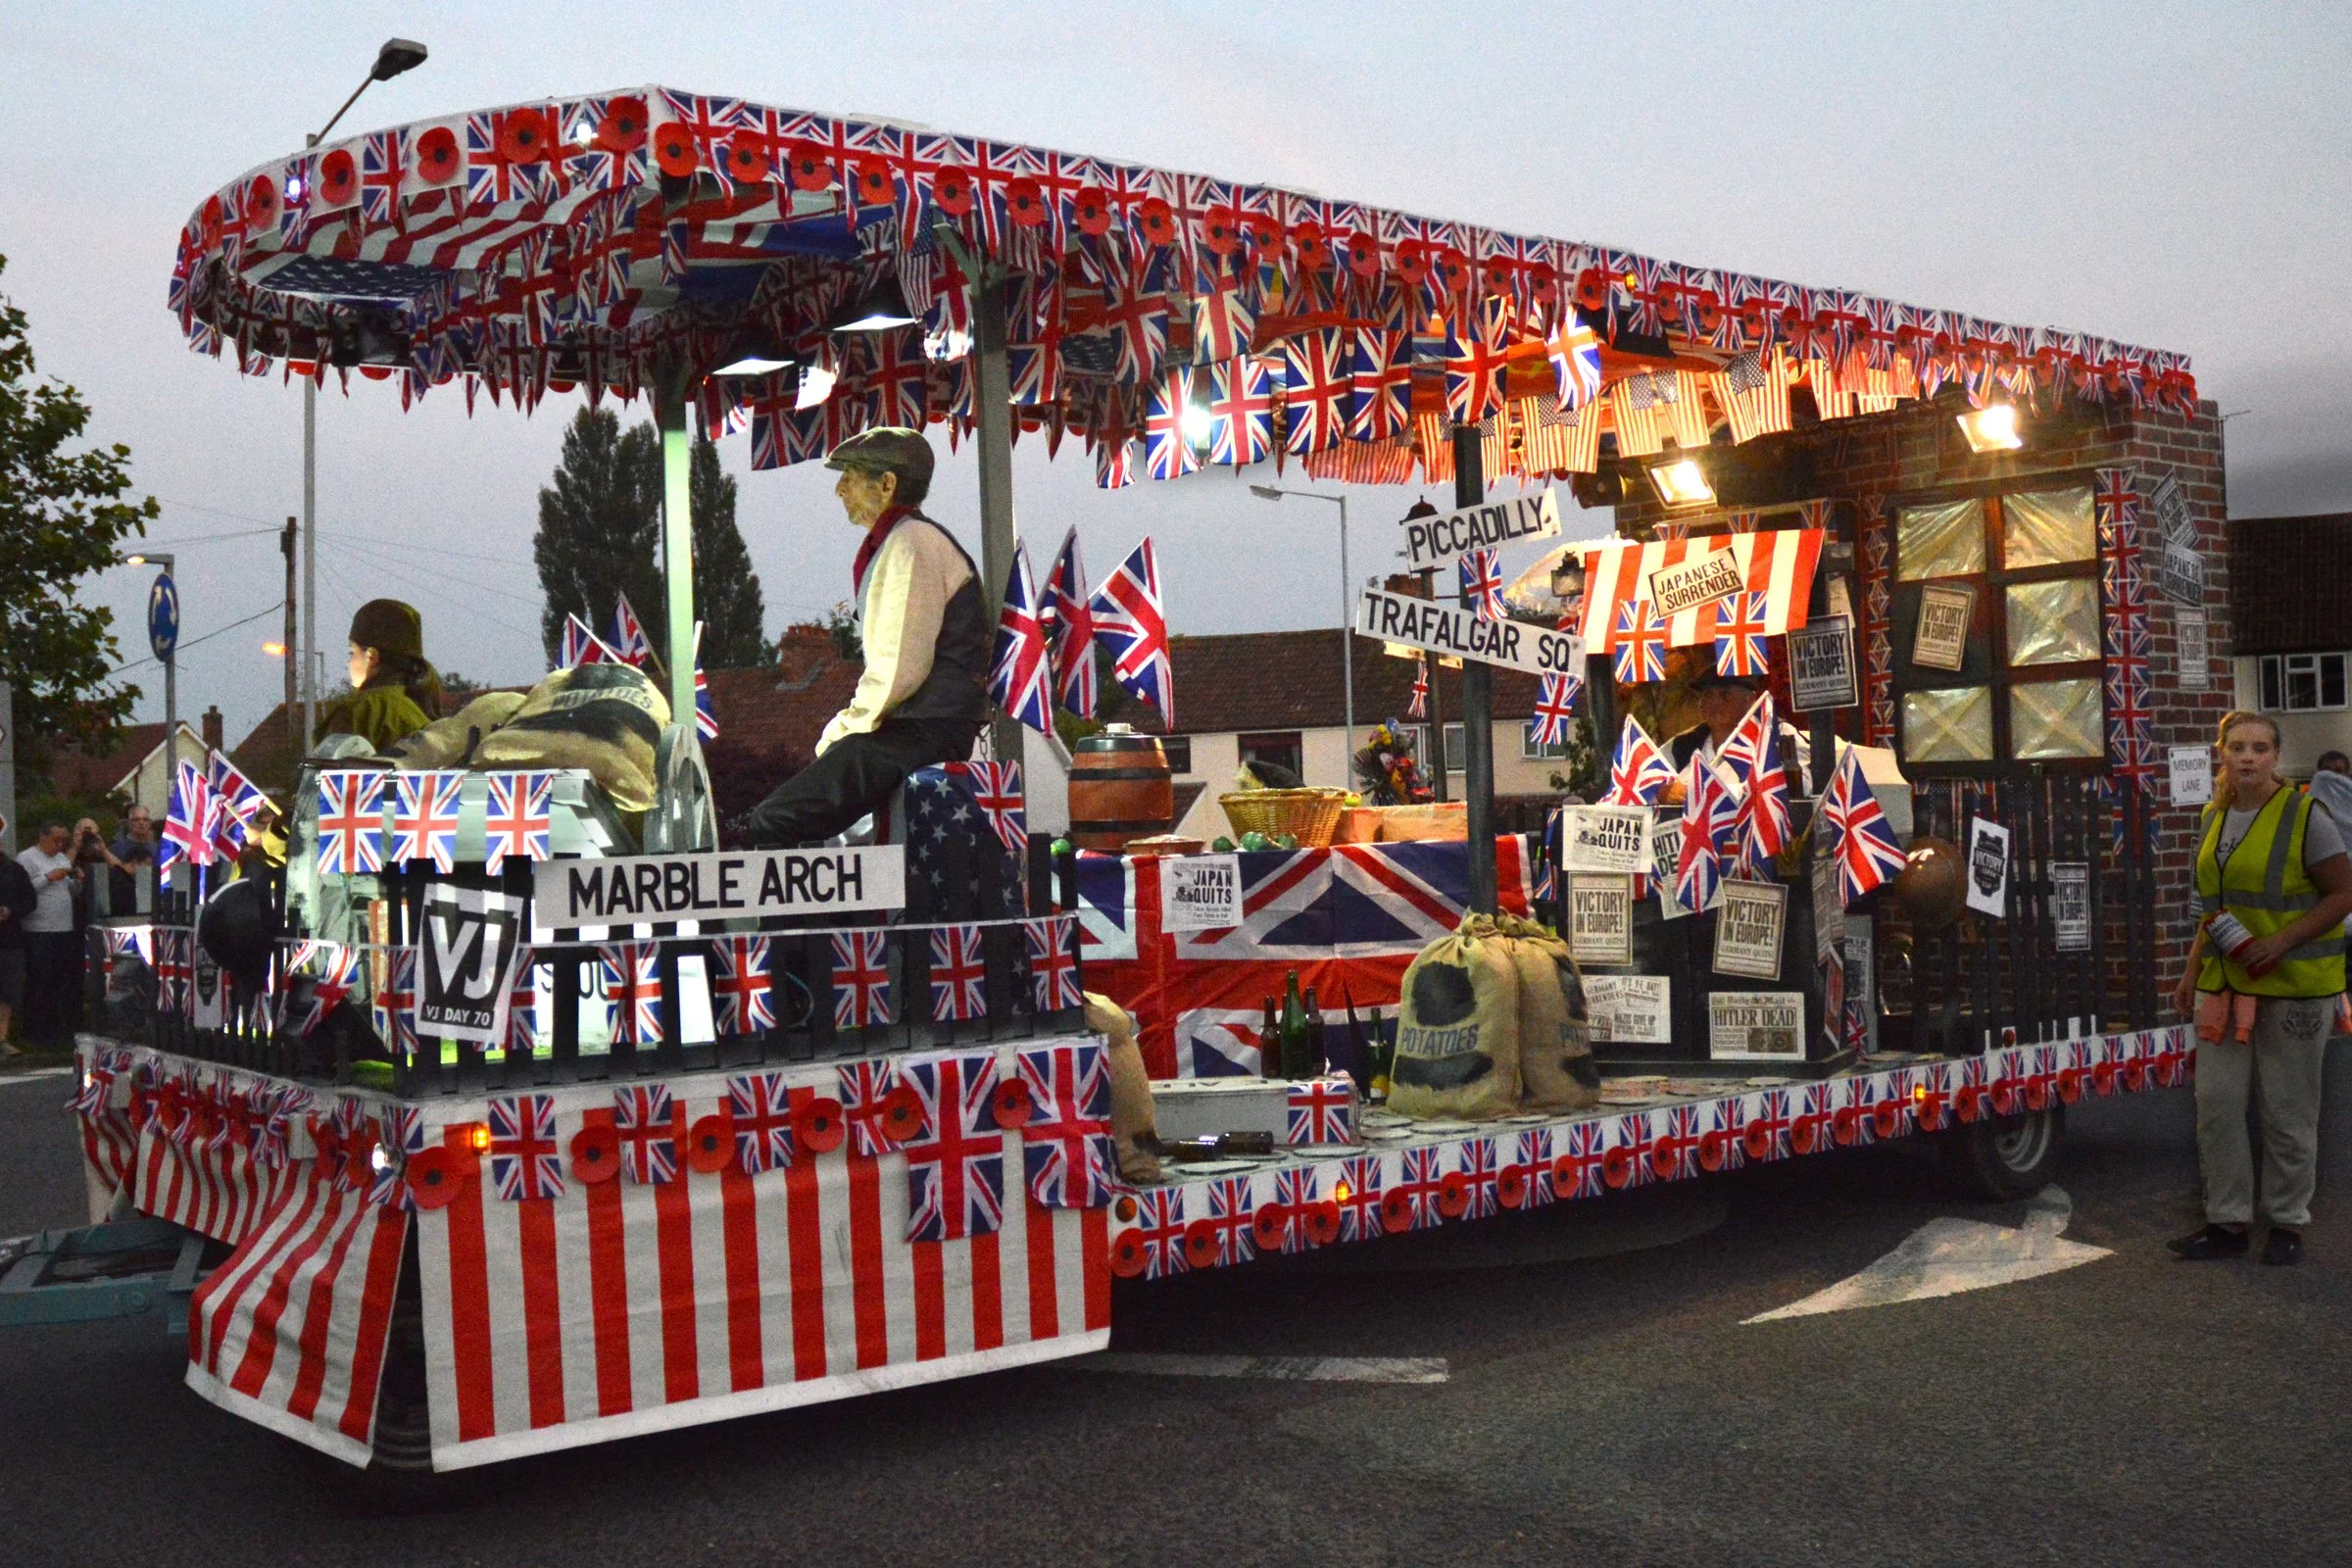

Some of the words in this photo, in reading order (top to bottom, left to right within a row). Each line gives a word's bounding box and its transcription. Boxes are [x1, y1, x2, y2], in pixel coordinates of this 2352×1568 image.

[1407, 496, 1544, 563] PICCADILLY
[1658, 558, 1728, 596] JAPANESE
[1665, 569, 1742, 610] SURRENDER
[1926, 603, 1964, 625] VICTORY
[1364, 591, 1520, 662] TRAFALGAR
[1537, 633, 1571, 672] SQ
[1793, 632, 1844, 660] VICTORY
[2173, 758, 2208, 771] MEMORY
[2181, 779, 2201, 793] LANE
[1599, 817, 1642, 836] JAPAN
[1598, 833, 1641, 852] QUITS
[1657, 854, 1679, 877] DE
[568, 858, 746, 918] MARBLE
[759, 853, 863, 906] ARCH
[1194, 869, 1232, 887] JAPAN
[1194, 887, 1232, 904] QUITS
[1575, 890, 1625, 912] VICTORY
[1725, 898, 1779, 926] VICTORY
[1576, 913, 1585, 933] IN
[1587, 913, 1623, 934] EUROPE!
[1723, 921, 1735, 942] IN
[1736, 922, 1774, 947] EUROPE!
[428, 914, 502, 1000] VJ
[1727, 996, 1750, 1006] Daily
[1764, 996, 1786, 1005] Mail
[425, 1004, 440, 1020] VJ
[444, 1007, 470, 1023] DAY
[473, 1011, 490, 1026] 70
[1714, 1008, 1757, 1027] HITLER
[1762, 1008, 1795, 1027] DEAD
[1400, 1023, 1479, 1056] POTATOES
